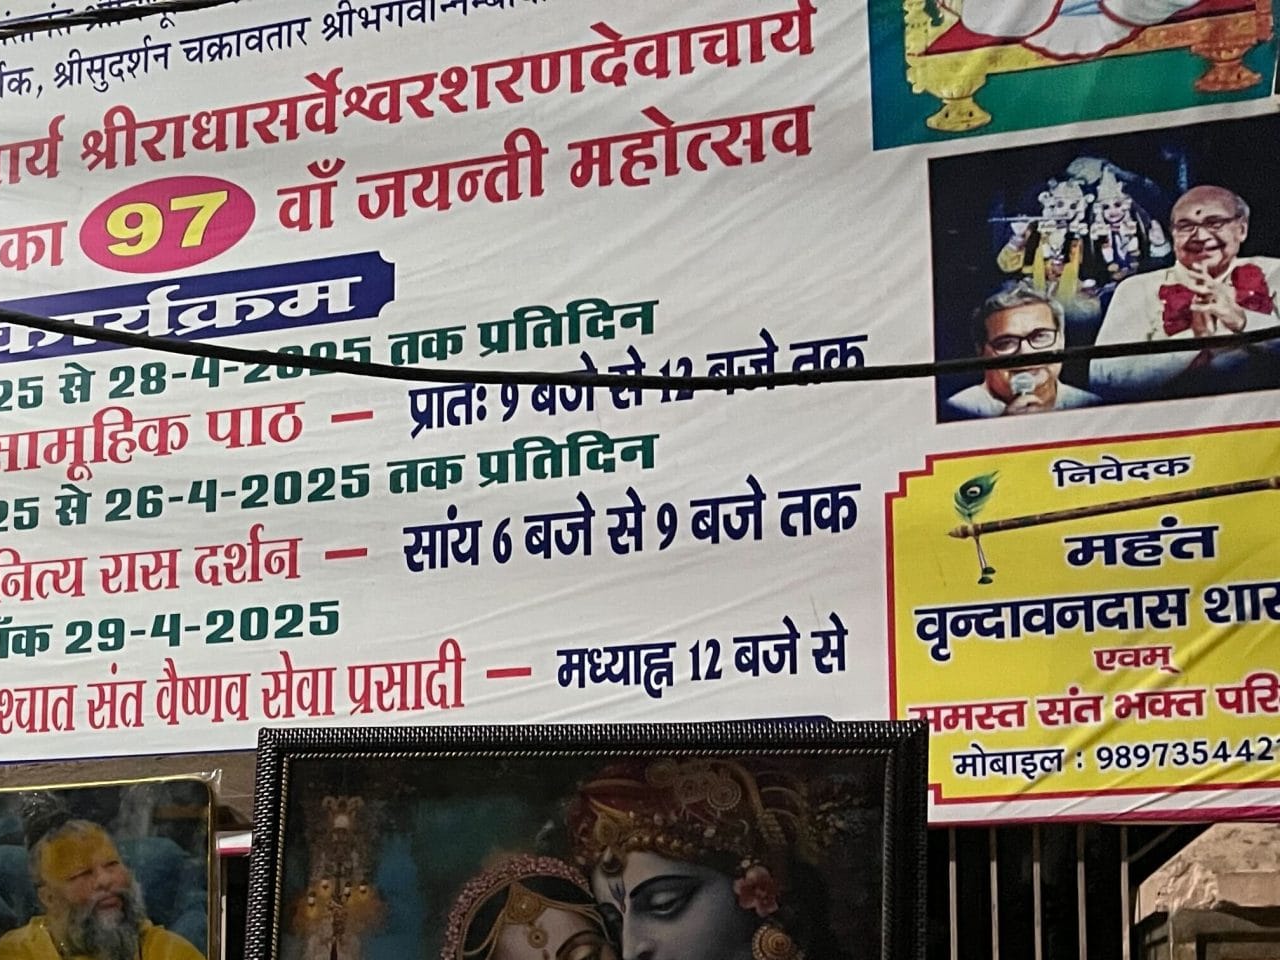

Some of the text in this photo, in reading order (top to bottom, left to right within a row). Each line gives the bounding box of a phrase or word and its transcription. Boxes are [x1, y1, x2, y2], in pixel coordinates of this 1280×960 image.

[54, 35, 171, 92] श्रीसुदर्शन
[179, 17, 311, 65] चक्रावतार
[81, 3, 817, 173] श्रीराधासर्वेश्वरशरणदेवाचार्य
[0, 220, 69, 272] का
[106, 189, 230, 258] 97
[278, 157, 347, 232] वाँ
[356, 127, 549, 221] जयन्ती
[568, 104, 817, 189] महोत्सव
[58, 362, 97, 405] से
[387, 325, 467, 367] तक
[477, 299, 659, 358] प्रतिदिन
[205, 400, 306, 451] पाठ
[531, 350, 598, 417] बजे
[609, 345, 647, 411] से
[706, 328, 779, 395] बजे
[790, 334, 869, 384] तक
[54, 484, 93, 527] से
[104, 463, 371, 523] 26-4-2025
[387, 454, 466, 494] तक
[477, 430, 660, 487] प्रतिदिन
[1052, 456, 1192, 488] निवेदक
[99, 549, 183, 595] रास
[194, 523, 303, 586] दर्शन
[403, 504, 483, 573] सांय
[492, 517, 514, 564] 6
[524, 491, 596, 560] बजे
[606, 486, 646, 554] से
[691, 474, 767, 542] बजे
[778, 482, 862, 538] तक
[1064, 516, 1219, 567] महंत
[65, 600, 341, 655] 29-4-2025
[915, 588, 1191, 661] वृन्दावनदास
[1094, 646, 1180, 674] एवम्
[87, 662, 147, 729] संत
[156, 657, 251, 725] वैष्णव
[261, 651, 337, 718] सेवा
[347, 637, 466, 714] प्रसादी
[688, 639, 723, 681] 12
[734, 614, 802, 676] बजे
[811, 612, 848, 673] से
[1037, 686, 1104, 726] संत
[1115, 689, 1206, 720] भक्त
[1215, 673, 1280, 714] परि
[953, 743, 1065, 780] मोबाइल
[1096, 737, 1280, 771] 989735442
